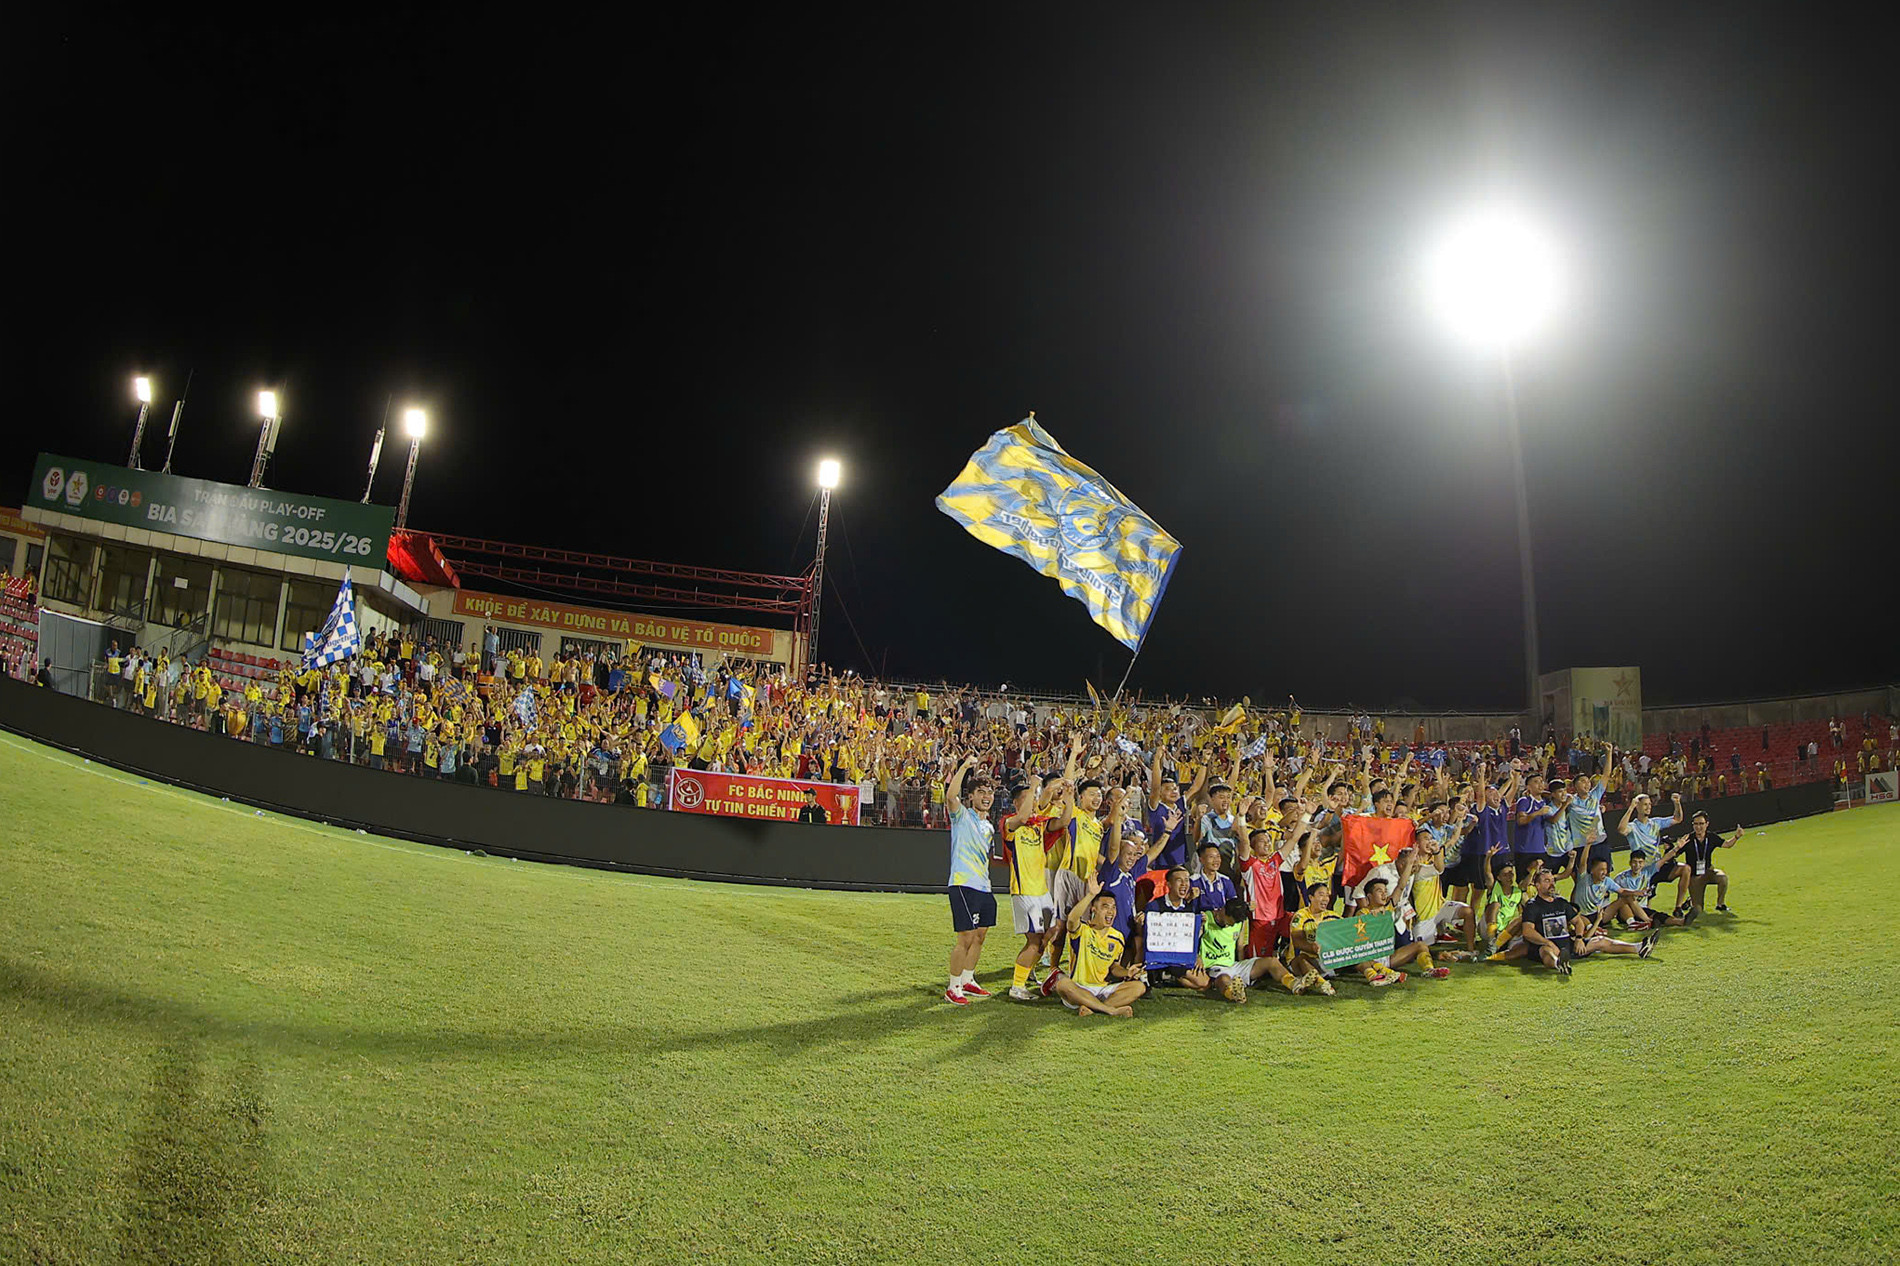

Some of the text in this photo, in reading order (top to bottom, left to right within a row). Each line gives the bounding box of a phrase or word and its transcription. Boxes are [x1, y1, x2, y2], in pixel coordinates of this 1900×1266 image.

[260, 502, 326, 521] PLAY-OFF
[148, 503, 177, 524] BIA
[223, 513, 278, 540] ÀNG
[282, 526, 372, 555] 2025/26
[507, 602, 528, 618] ĐỂ
[530, 608, 560, 623] XÂY
[564, 612, 606, 629] DỰNG
[611, 618, 630, 633] VÀ
[634, 621, 666, 637] BẢO
[671, 626, 690, 643] VỆ
[695, 626, 715, 642] TỔ
[718, 630, 761, 647] QUỐC
[729, 784, 745, 797] FC
[747, 783, 774, 799] BẮC
[704, 799, 721, 814] TỰ
[723, 801, 744, 814] TIN
[747, 802, 786, 818] CHIẾN
[1322, 951, 1335, 959] CLB
